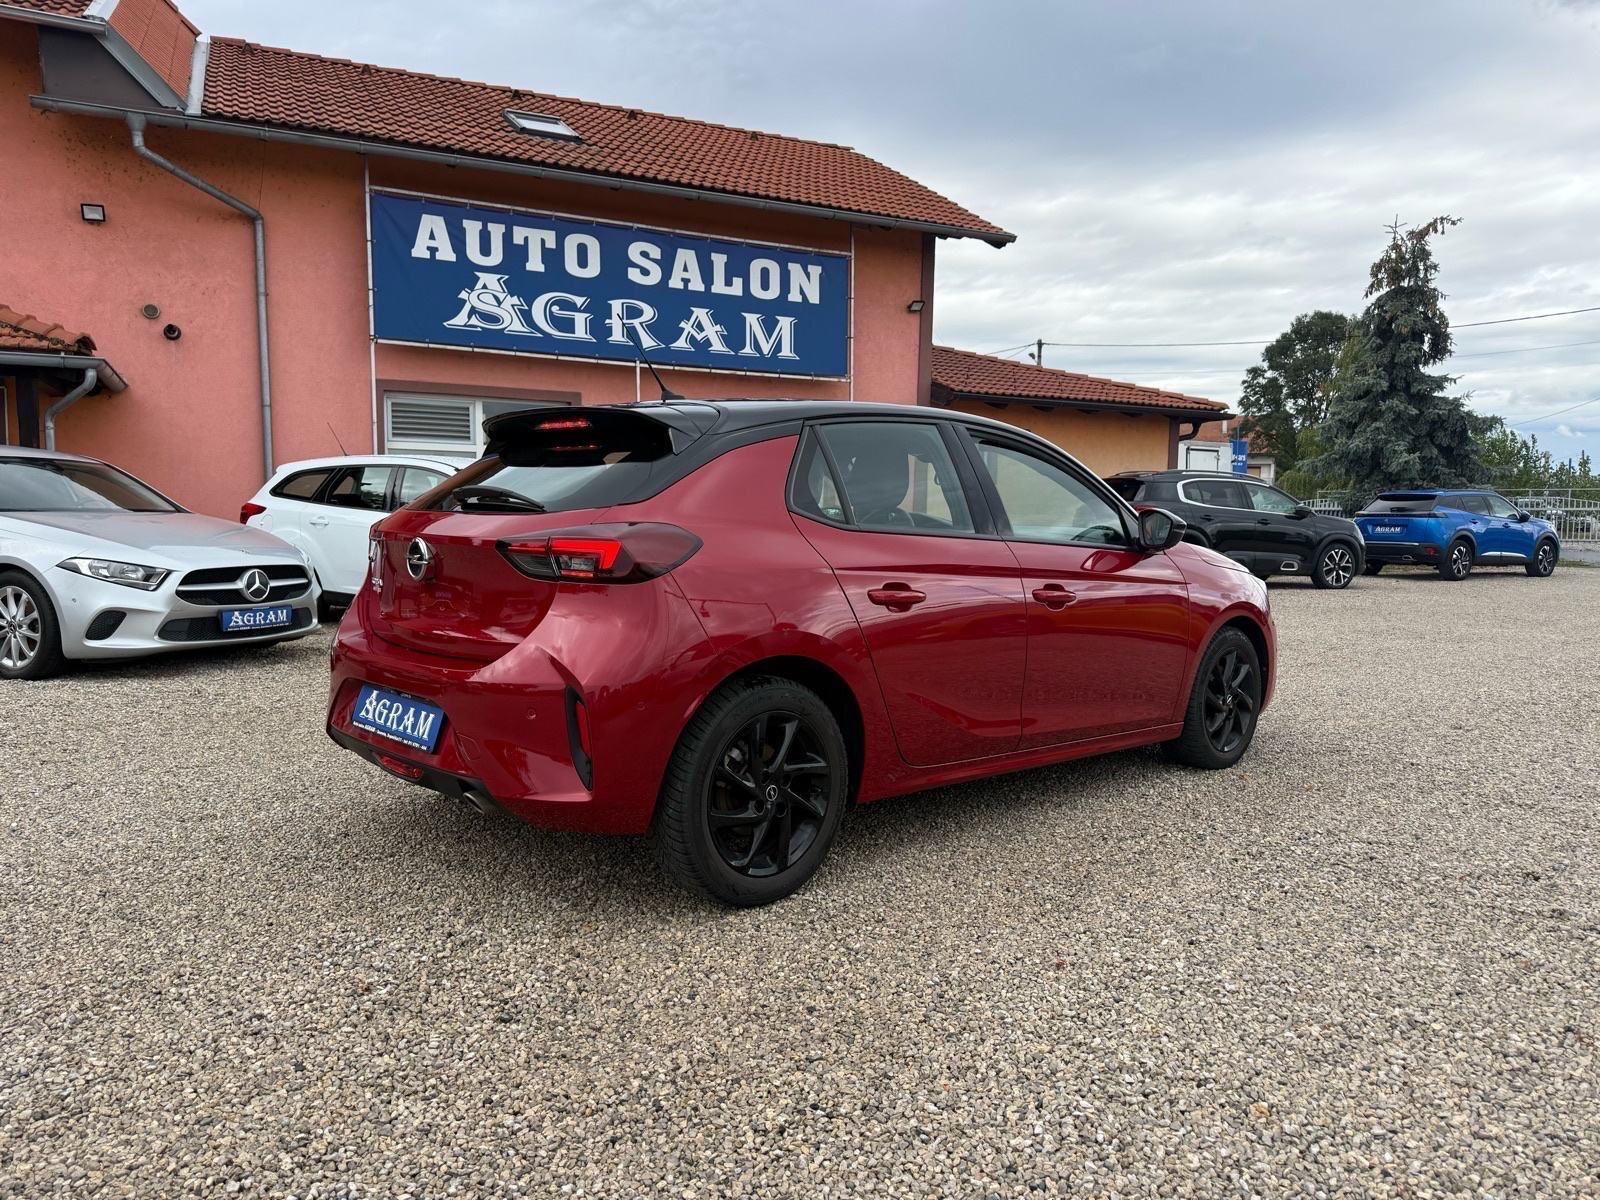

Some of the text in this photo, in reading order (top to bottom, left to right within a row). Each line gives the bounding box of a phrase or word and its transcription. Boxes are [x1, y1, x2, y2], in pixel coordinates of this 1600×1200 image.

[411, 213, 823, 304] AUTO SALON
[229, 609, 287, 626] AGRAM
[359, 690, 435, 741] AGRAM
